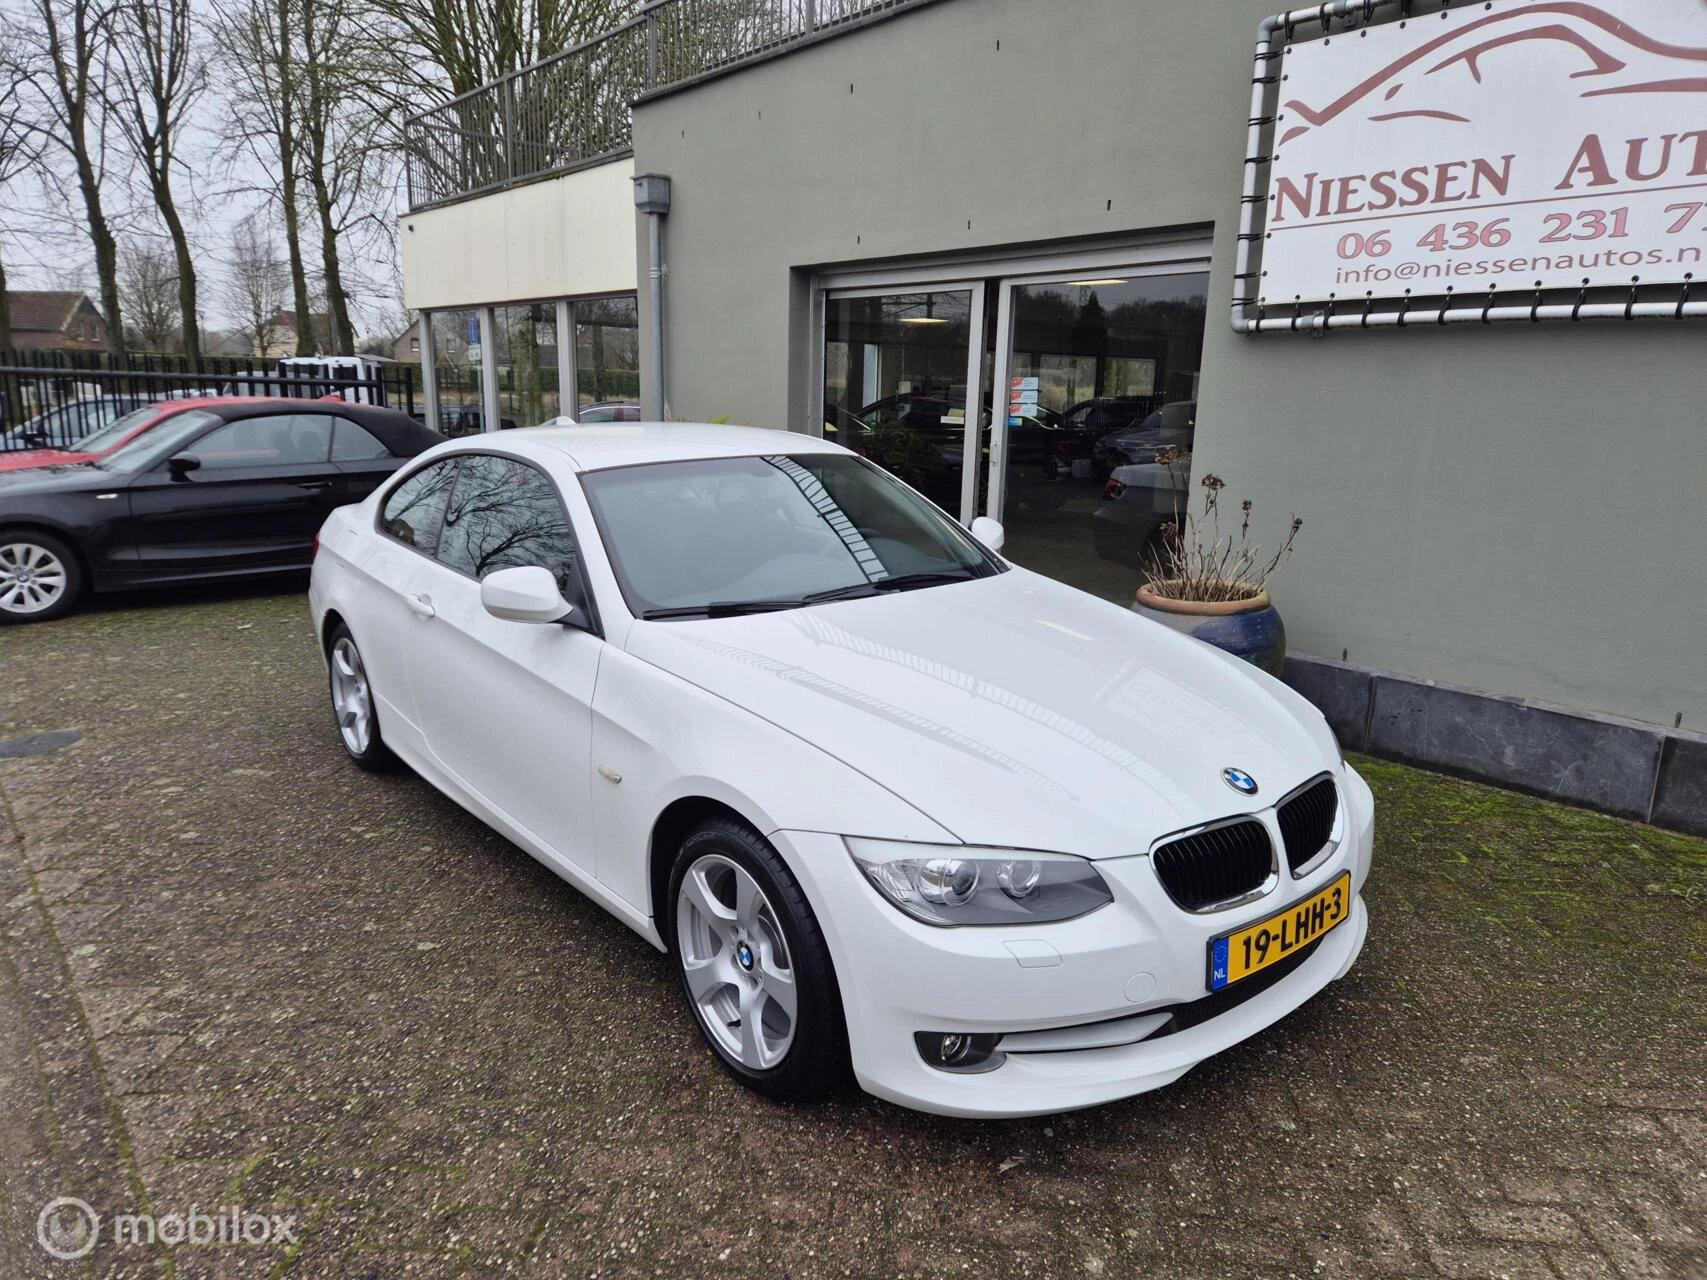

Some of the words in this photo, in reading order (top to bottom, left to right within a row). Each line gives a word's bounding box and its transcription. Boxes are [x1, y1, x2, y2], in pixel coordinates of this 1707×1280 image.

[1271, 154, 1516, 222] NIESSEN
[1336, 230, 1392, 259] 06
[1416, 217, 1511, 252] 436
[1538, 207, 1629, 244] 231
[1663, 201, 1707, 234] 7
[1242, 887, 1342, 970] 19-LHH-3
[1213, 967, 1226, 981] NL
